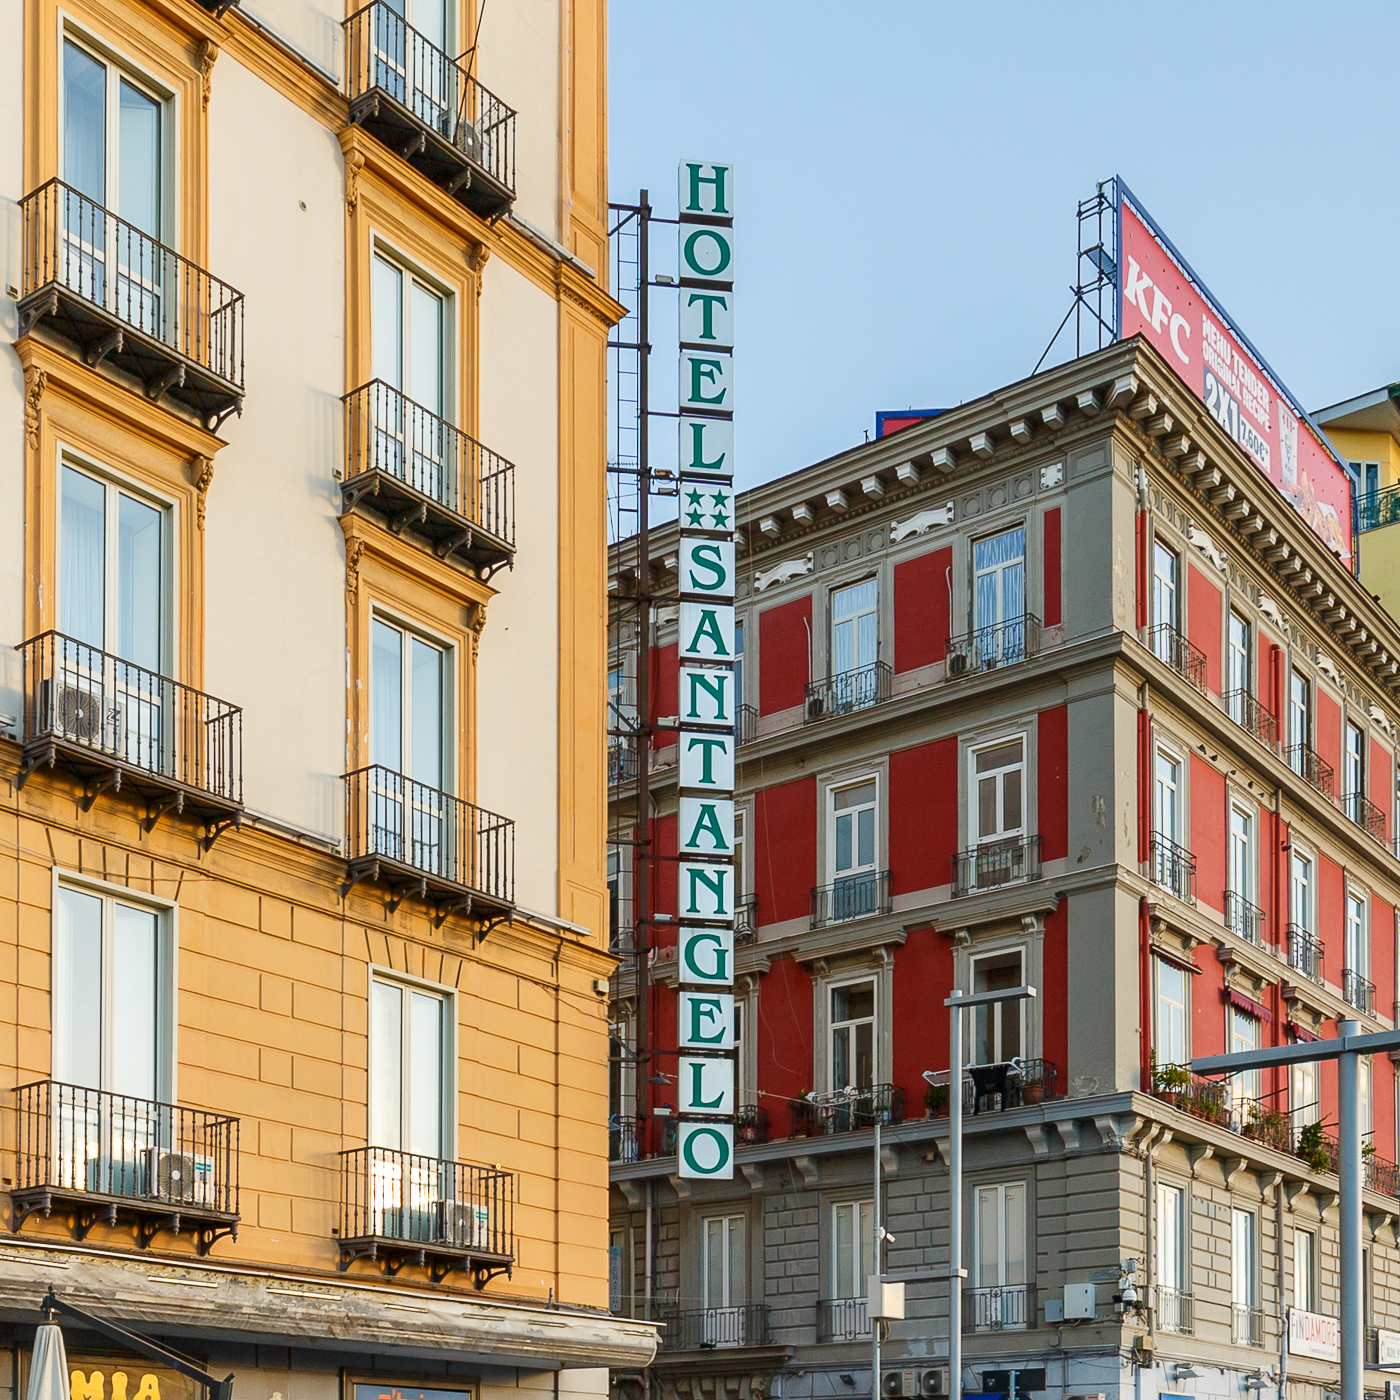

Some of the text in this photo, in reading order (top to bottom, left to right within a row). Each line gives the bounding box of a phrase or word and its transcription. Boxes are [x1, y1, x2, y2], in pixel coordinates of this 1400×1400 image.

[684, 163, 731, 470] HOTEL
[1123, 254, 1191, 365] KFC
[1202, 340, 1270, 434] ORIGINAL RECIPE
[1232, 349, 1270, 414] TENDER
